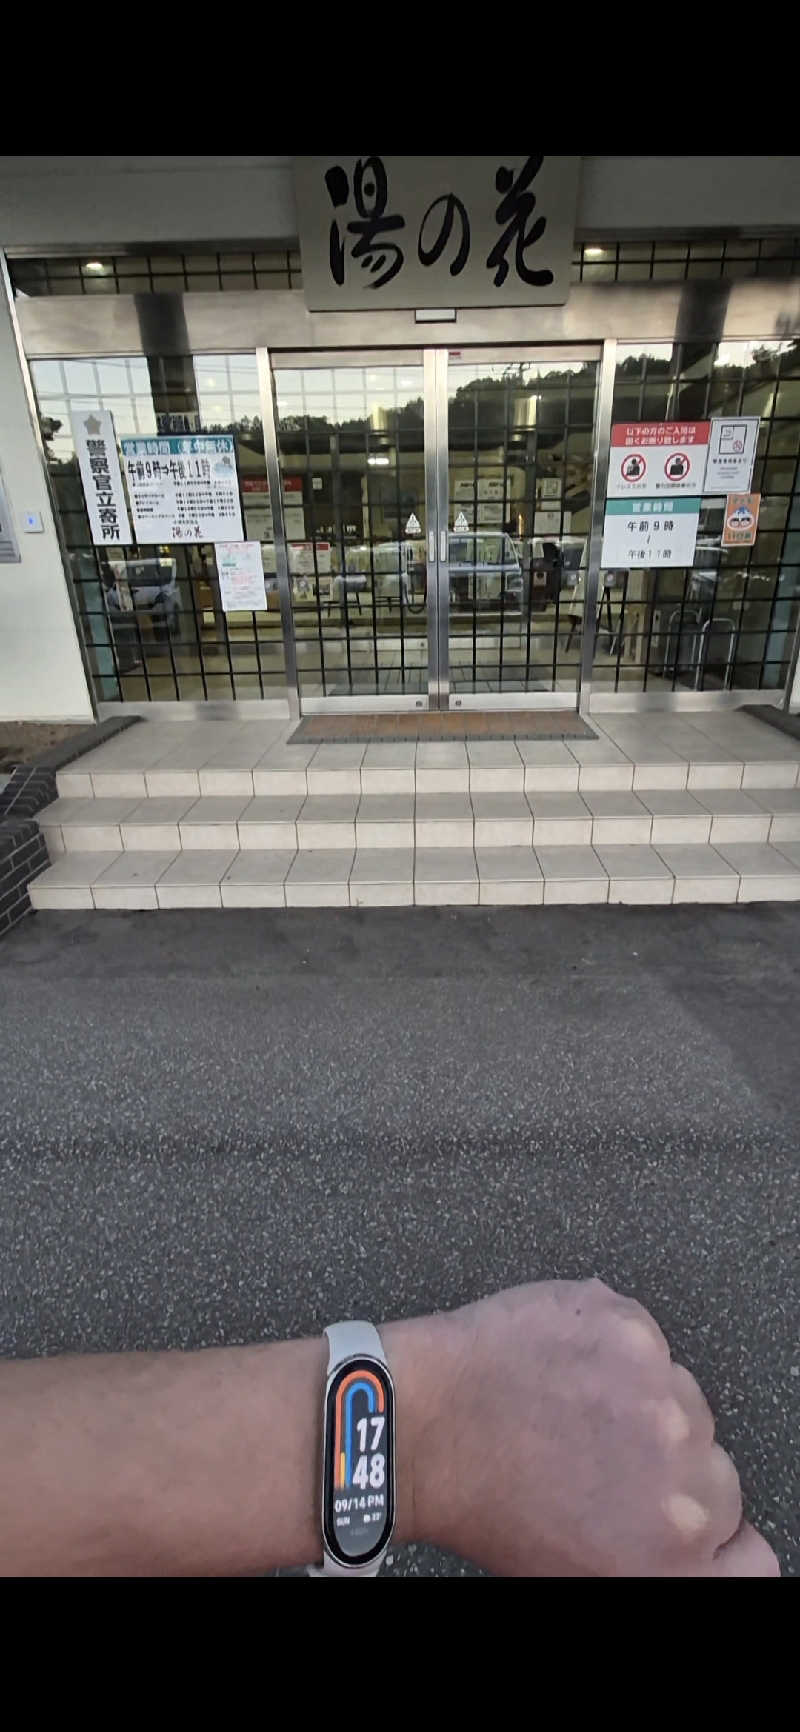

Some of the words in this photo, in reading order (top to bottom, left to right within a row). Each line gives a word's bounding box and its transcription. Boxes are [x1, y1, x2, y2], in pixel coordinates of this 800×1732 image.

[325, 155, 554, 289] 湯の花
[86, 439, 120, 540] 警察官立寄所
[356, 1417, 385, 1452] 17
[352, 1454, 386, 1489] 48
[335, 1498, 365, 1513] 09/14
[367, 1494, 385, 1507] PM
